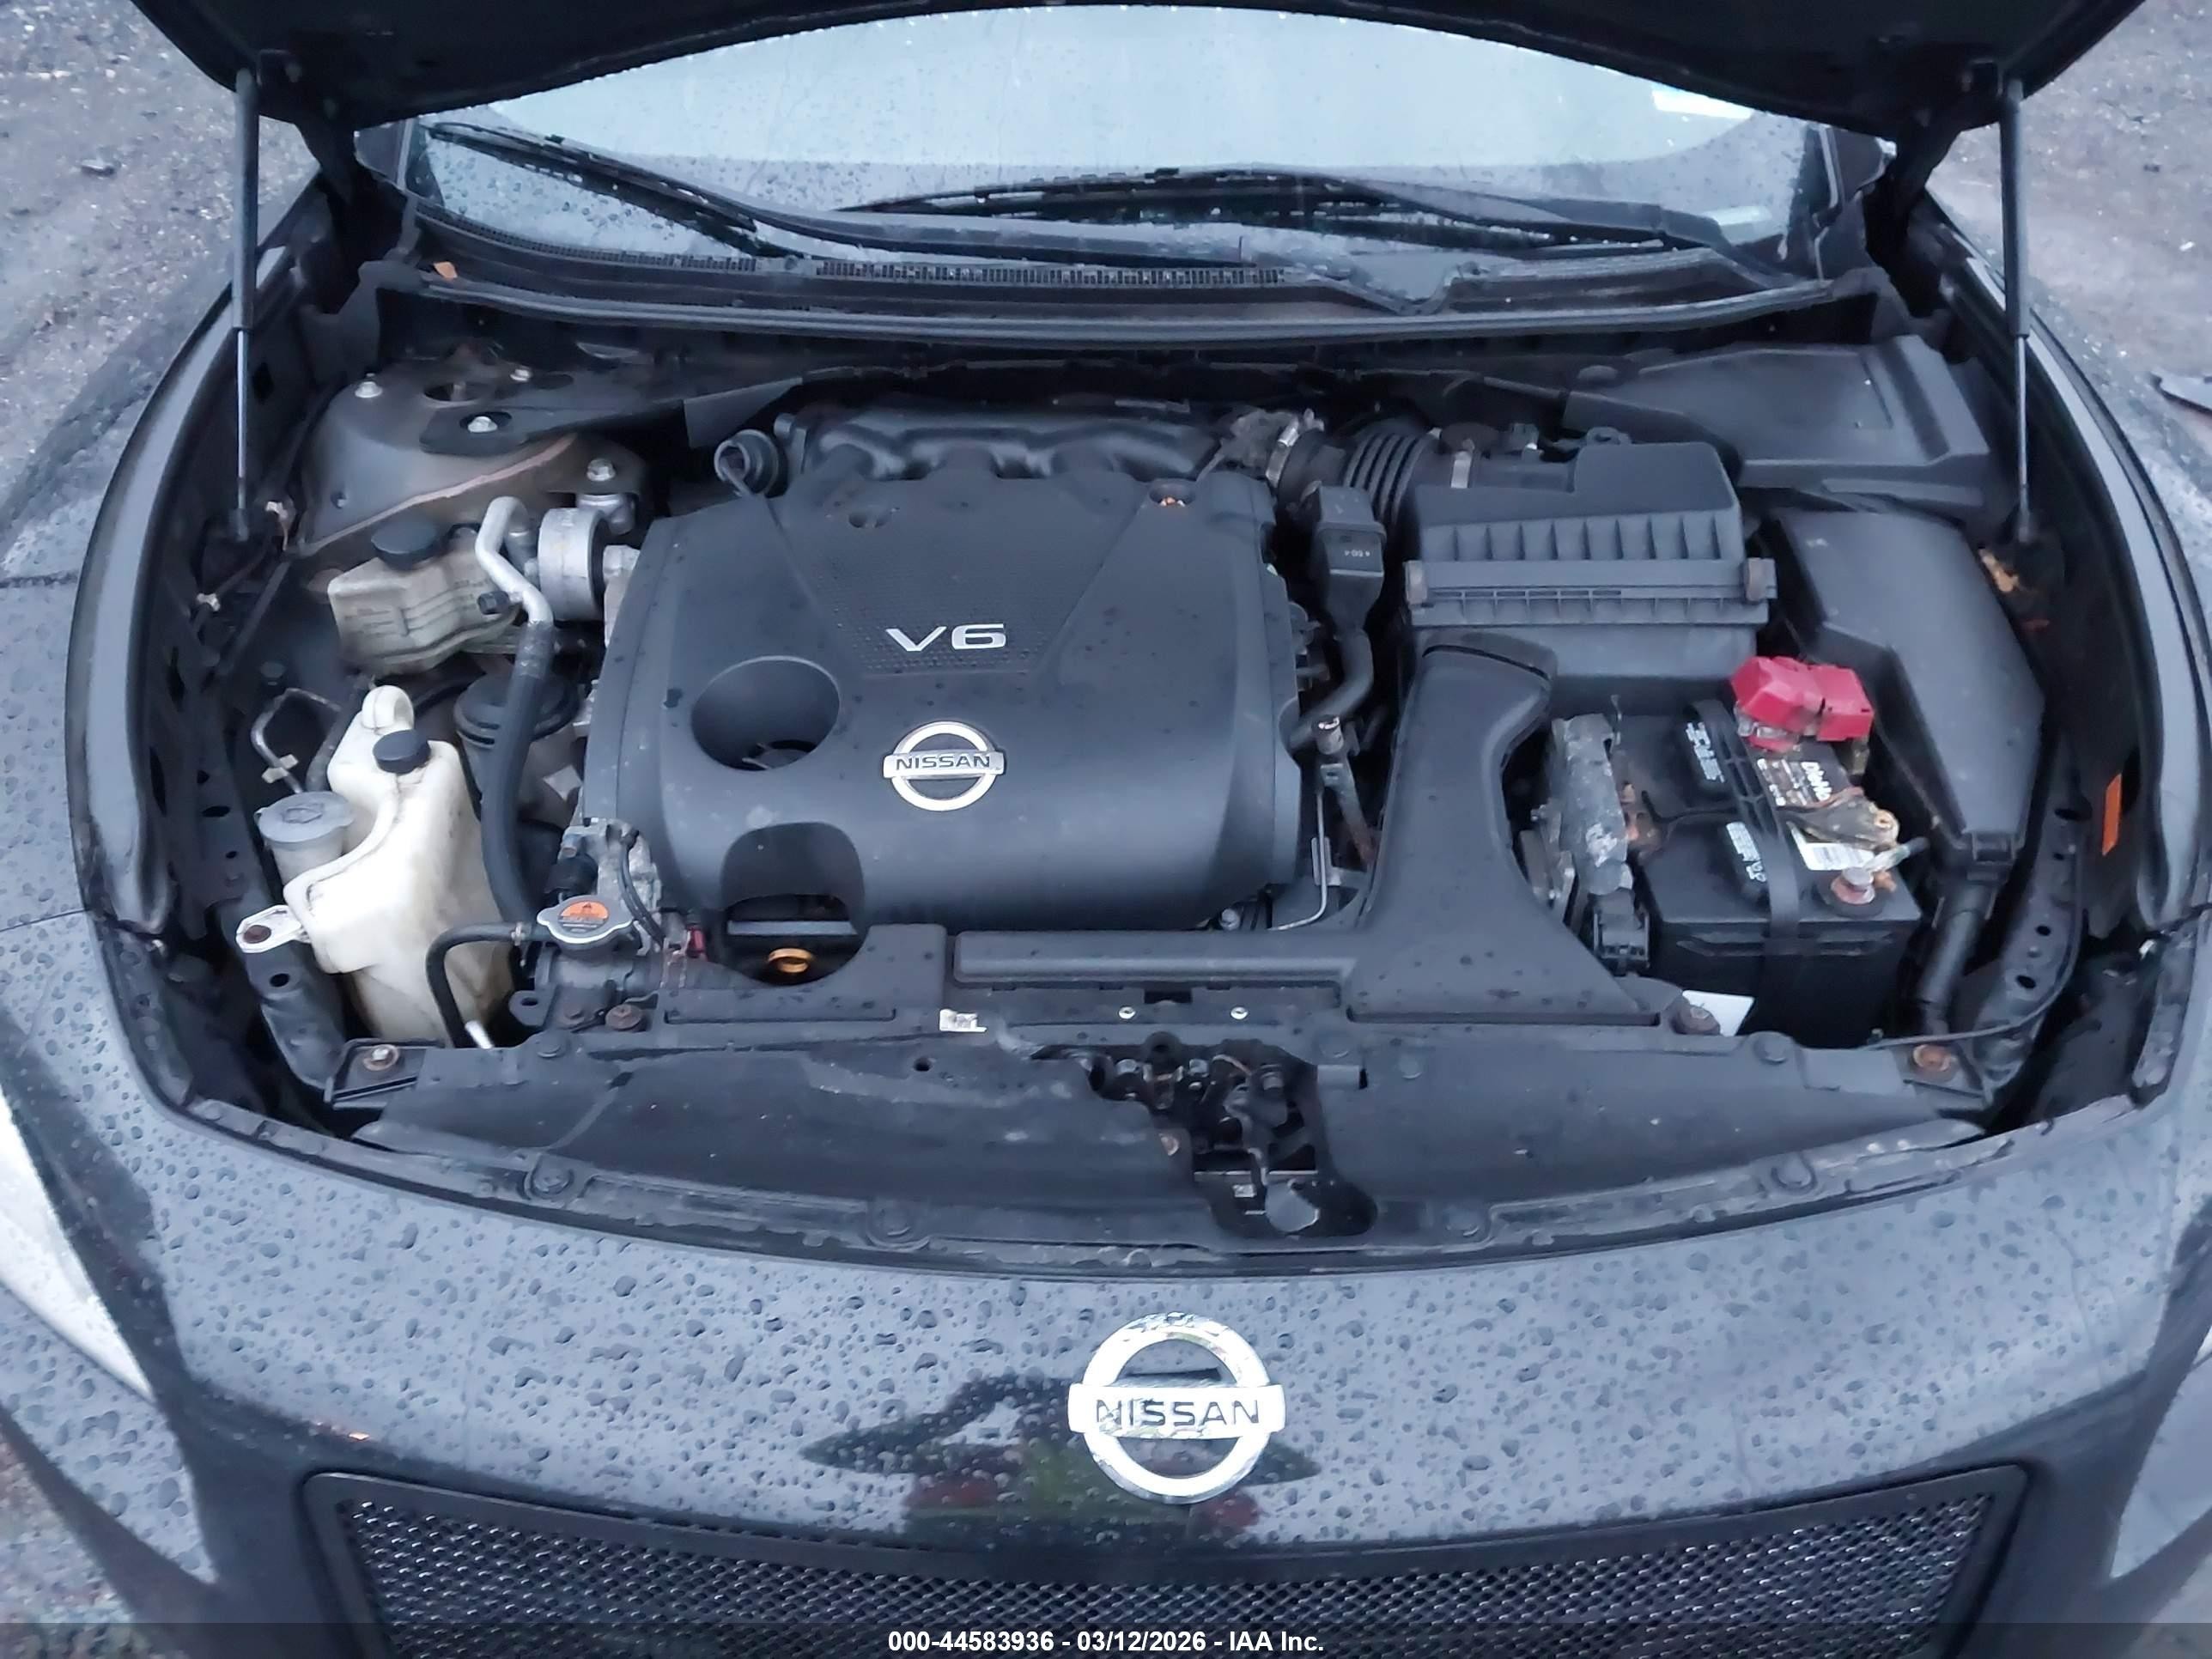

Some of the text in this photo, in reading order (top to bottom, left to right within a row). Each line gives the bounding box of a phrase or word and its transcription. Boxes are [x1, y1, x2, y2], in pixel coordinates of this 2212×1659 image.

[885, 623, 1006, 651] V6
[896, 754, 990, 770] NISSAN
[1096, 1399, 1260, 1426] NISSAN
